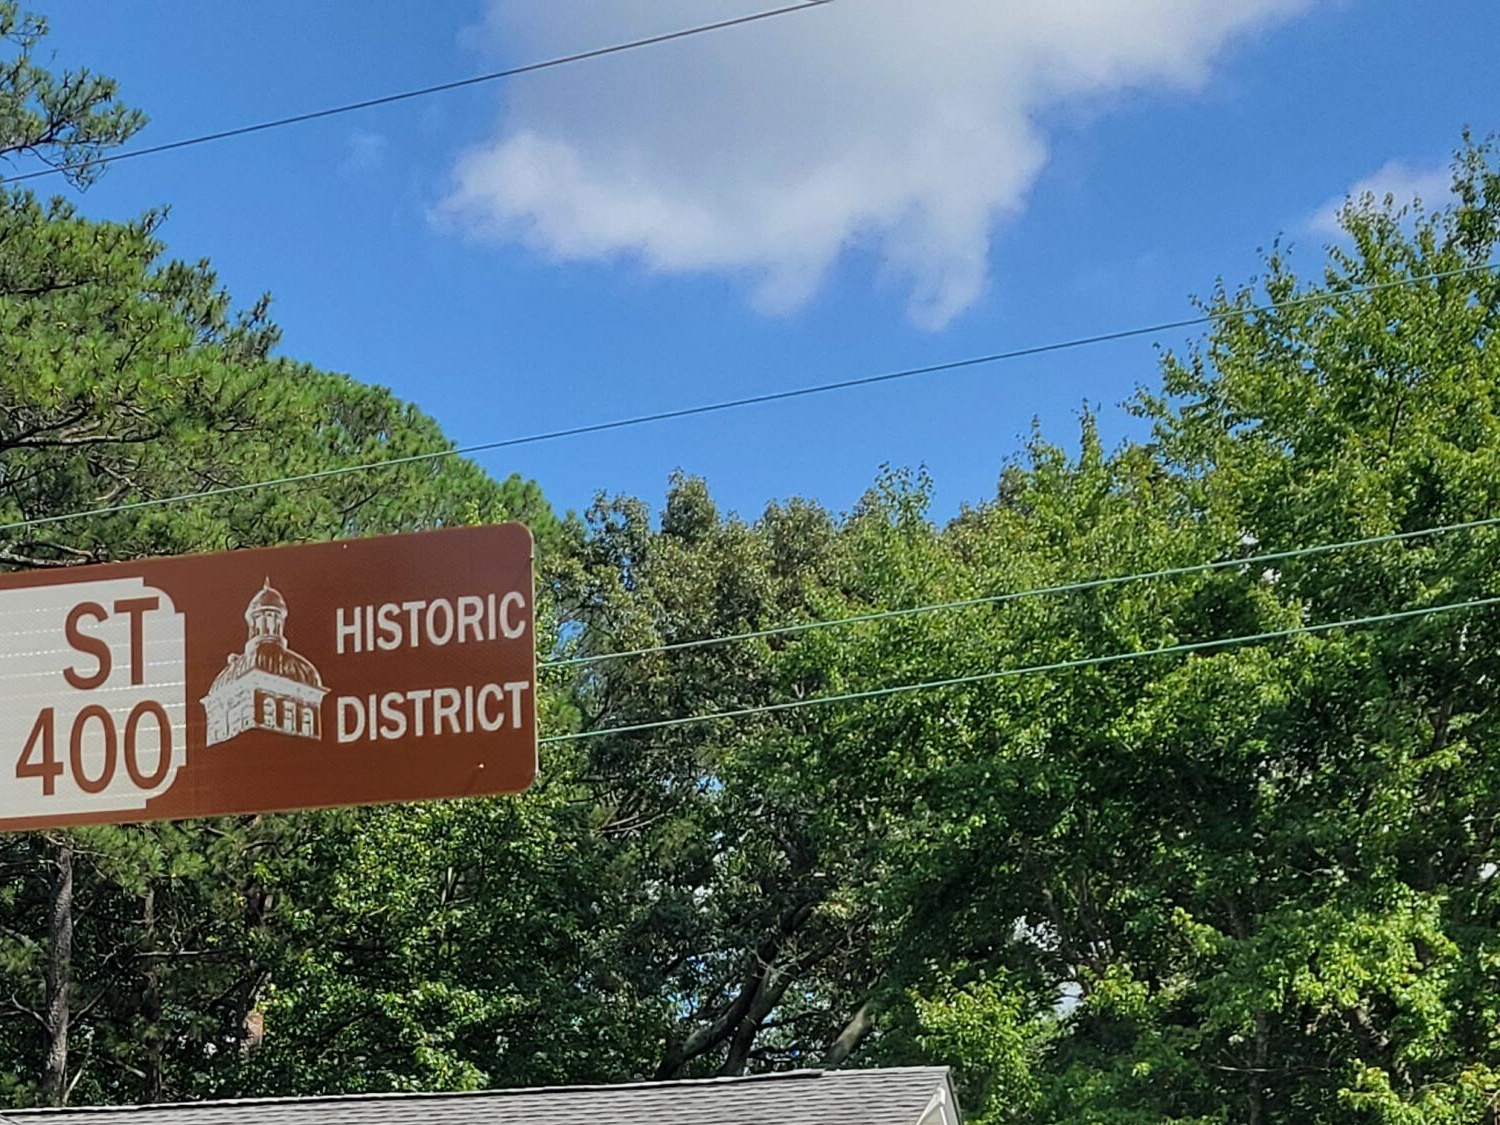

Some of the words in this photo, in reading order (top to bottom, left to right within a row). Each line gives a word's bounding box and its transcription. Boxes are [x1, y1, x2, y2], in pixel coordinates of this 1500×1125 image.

[63, 597, 159, 690] ST
[336, 591, 526, 654] HISTORIC
[16, 700, 172, 796] 400
[336, 681, 530, 743] DISTRICT
